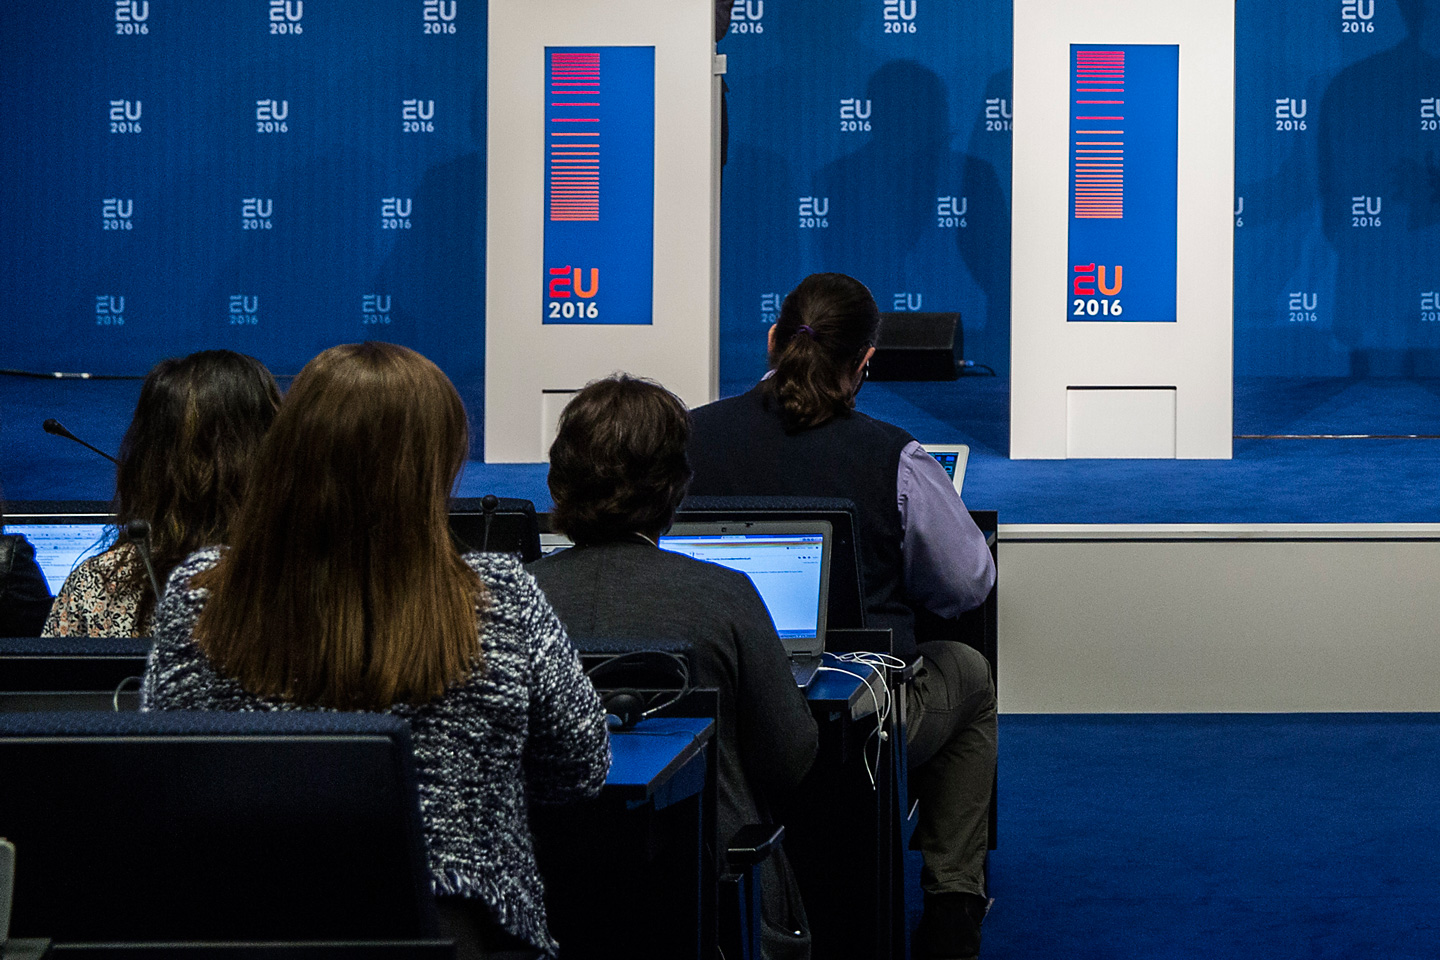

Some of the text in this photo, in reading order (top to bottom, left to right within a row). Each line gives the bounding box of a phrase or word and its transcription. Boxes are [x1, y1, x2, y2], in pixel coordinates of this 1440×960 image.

[115, 22, 150, 35] 2016
[269, 22, 304, 35] 2016
[423, 22, 457, 35] 2016
[730, 22, 764, 34] 2016
[883, 21, 917, 34] 2016
[1341, 21, 1375, 34] 2016
[110, 121, 142, 134] 2016
[256, 121, 289, 133] 2016
[402, 121, 435, 133] 2016
[839, 120, 872, 132] 2016
[1275, 119, 1308, 131] 2016
[103, 219, 133, 231] 2016
[799, 217, 829, 229] 2016
[1352, 216, 1382, 228] 2016
[549, 265, 599, 299] EU
[1073, 263, 1123, 296] EU
[549, 301, 599, 319] 2016
[1073, 299, 1123, 316] 2016
